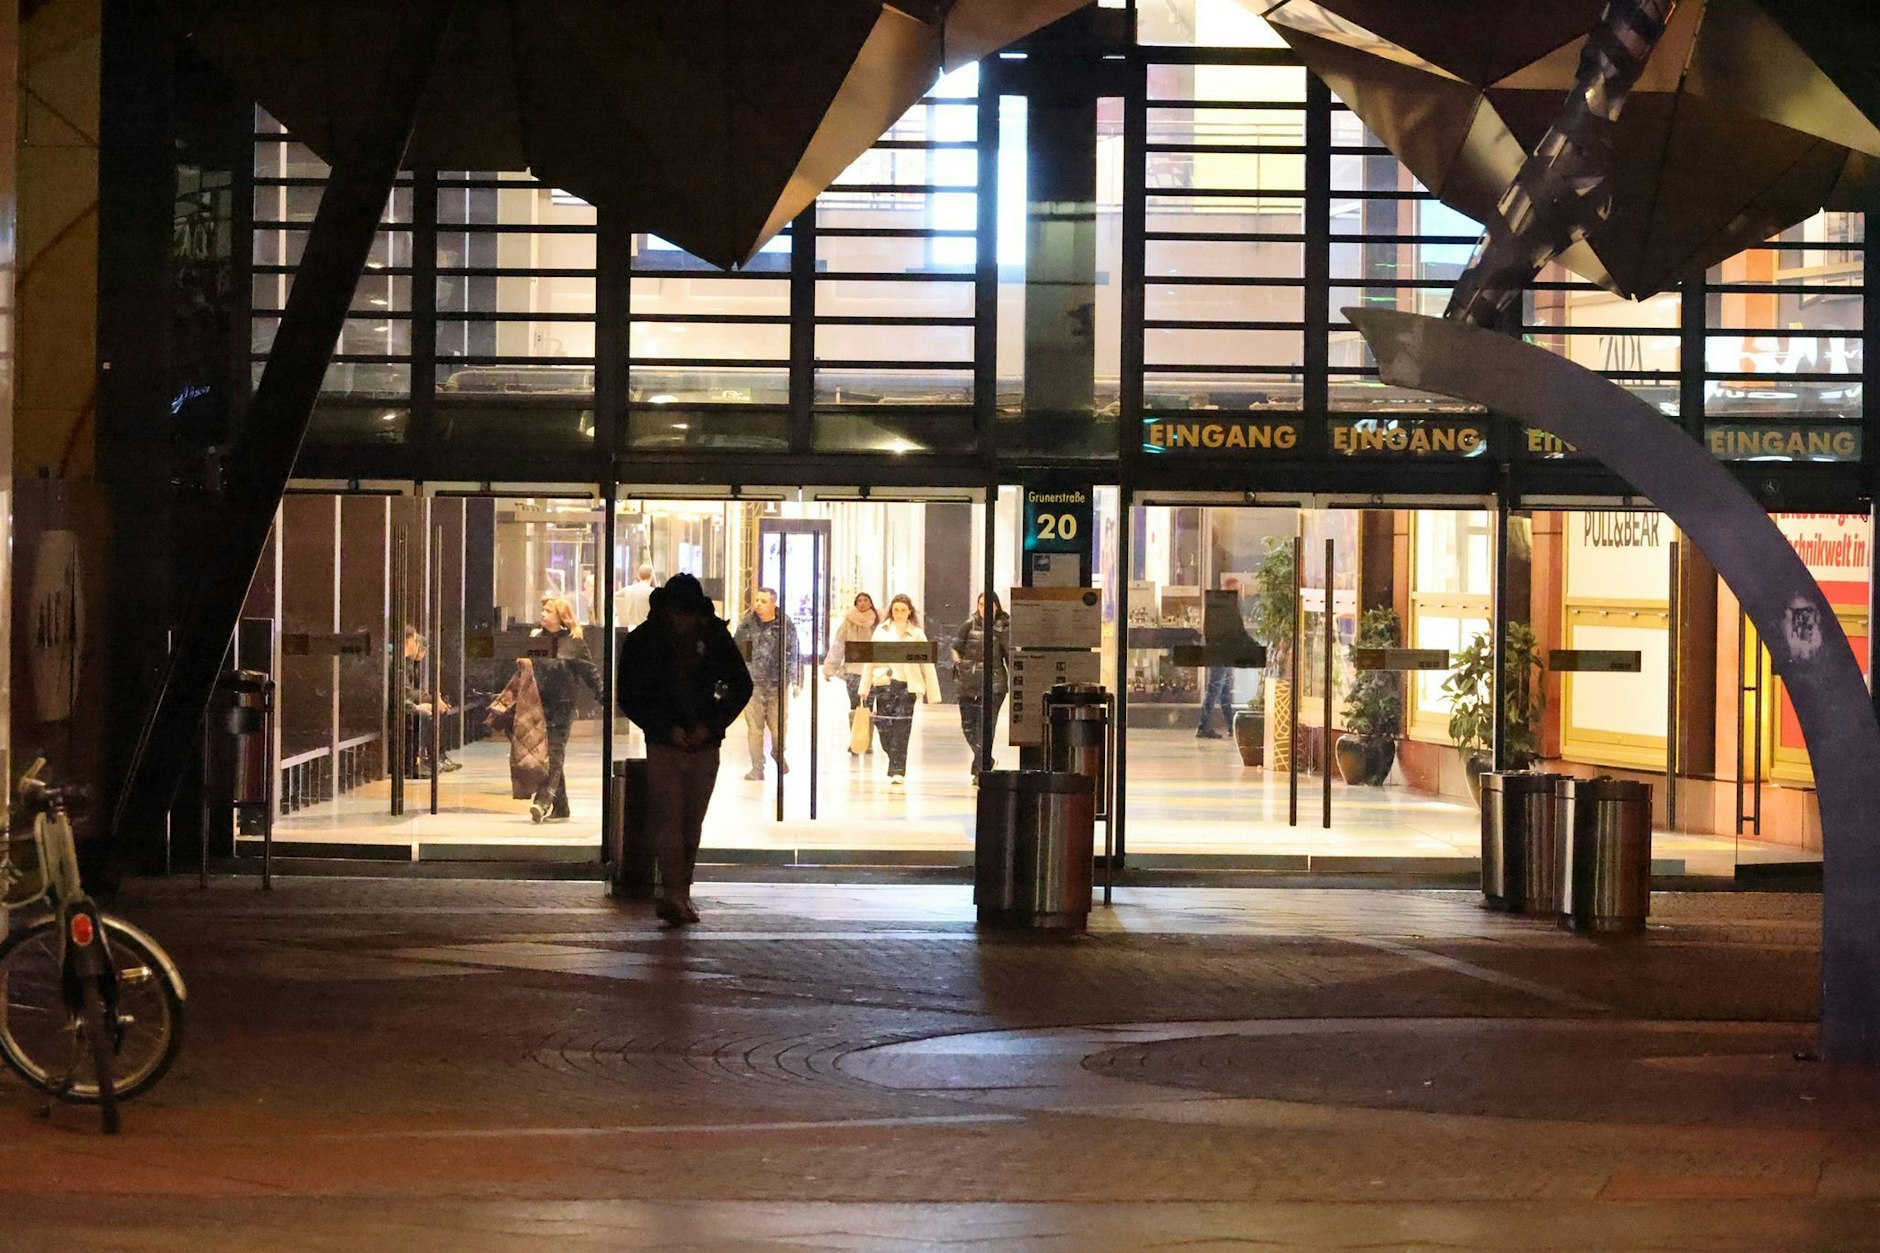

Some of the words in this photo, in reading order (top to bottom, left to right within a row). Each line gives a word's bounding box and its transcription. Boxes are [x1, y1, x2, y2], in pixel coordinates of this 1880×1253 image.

[1150, 424, 1297, 449] EINGANG
[1333, 427, 1481, 452] EINGANG
[1711, 431, 1855, 455] EINGANG
[1028, 491, 1086, 503] Grunerstraße
[1037, 513, 1077, 540] 20
[1584, 512, 1659, 548] PULL&BEAR
[1853, 533, 1866, 567] in
